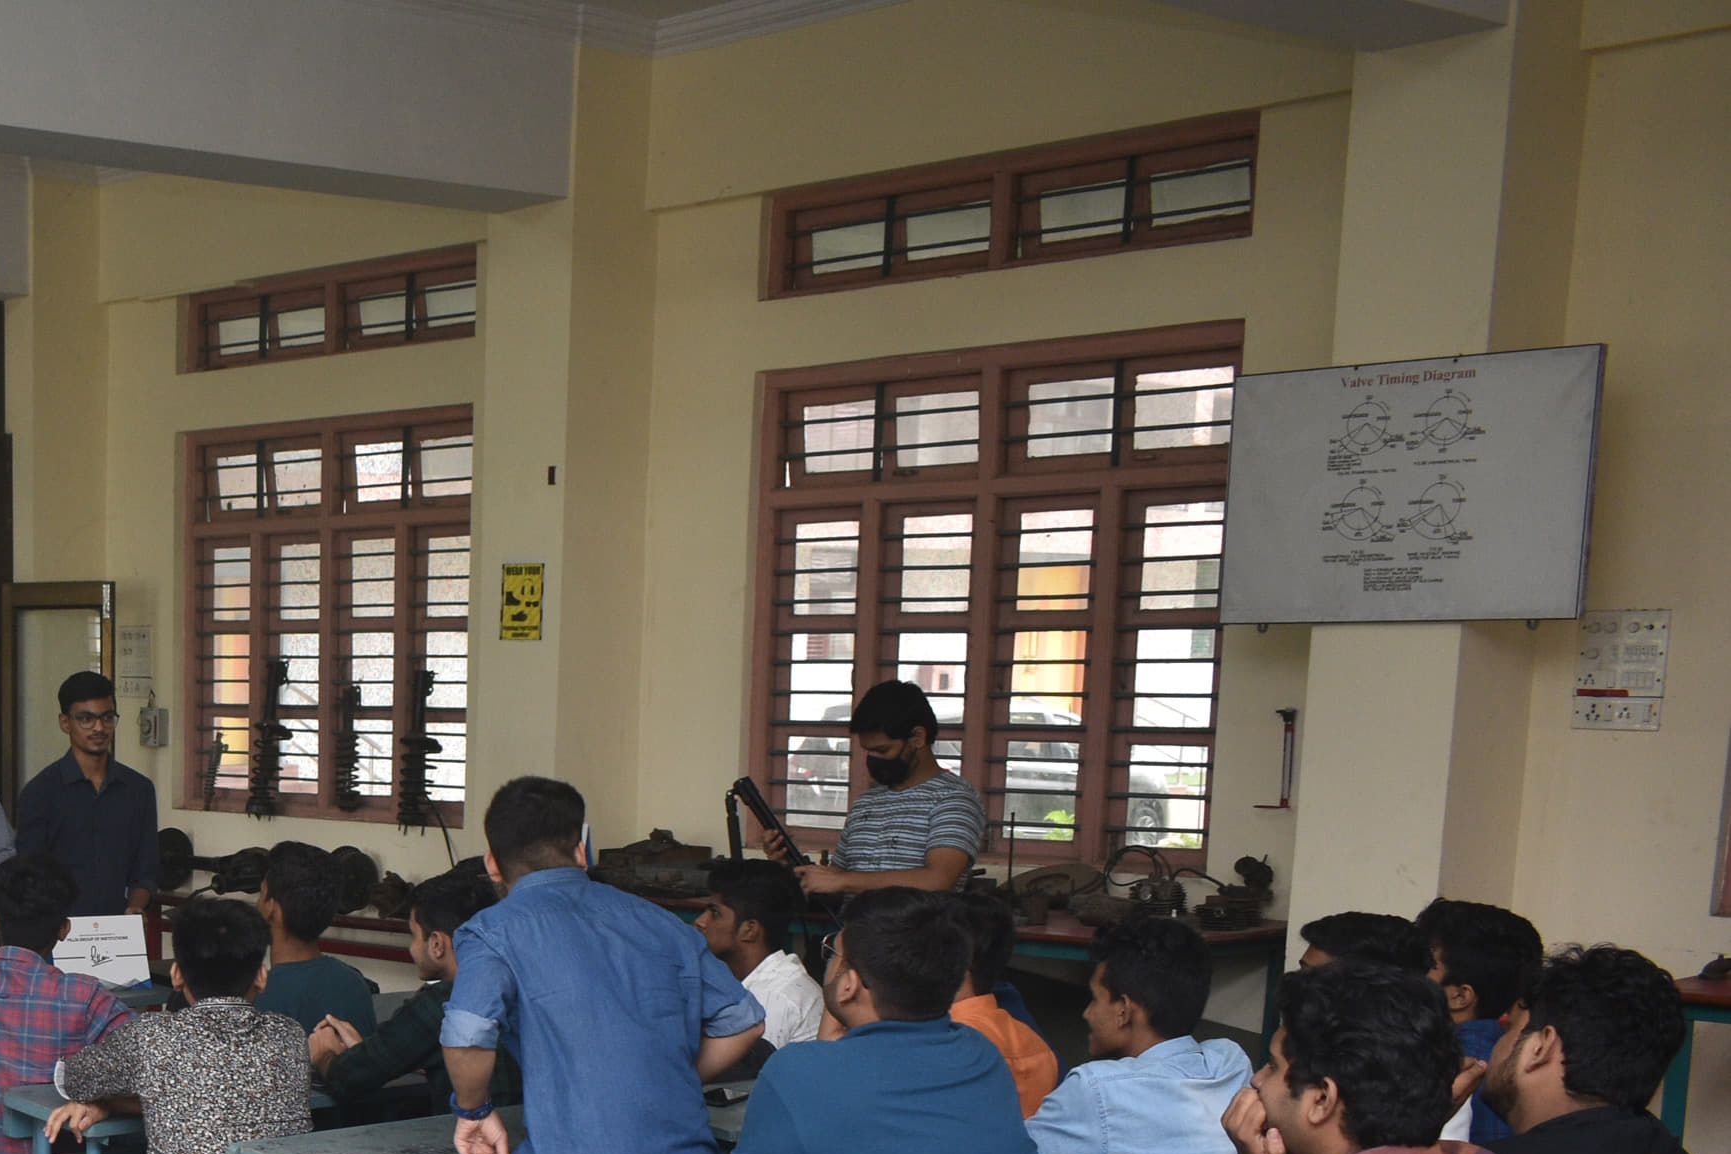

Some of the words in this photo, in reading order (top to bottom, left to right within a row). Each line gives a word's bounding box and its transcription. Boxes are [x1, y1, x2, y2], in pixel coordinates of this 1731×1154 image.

[1341, 376, 1374, 389] Valve
[1377, 373, 1420, 385] Timing
[1423, 368, 1477, 383] Diagram
